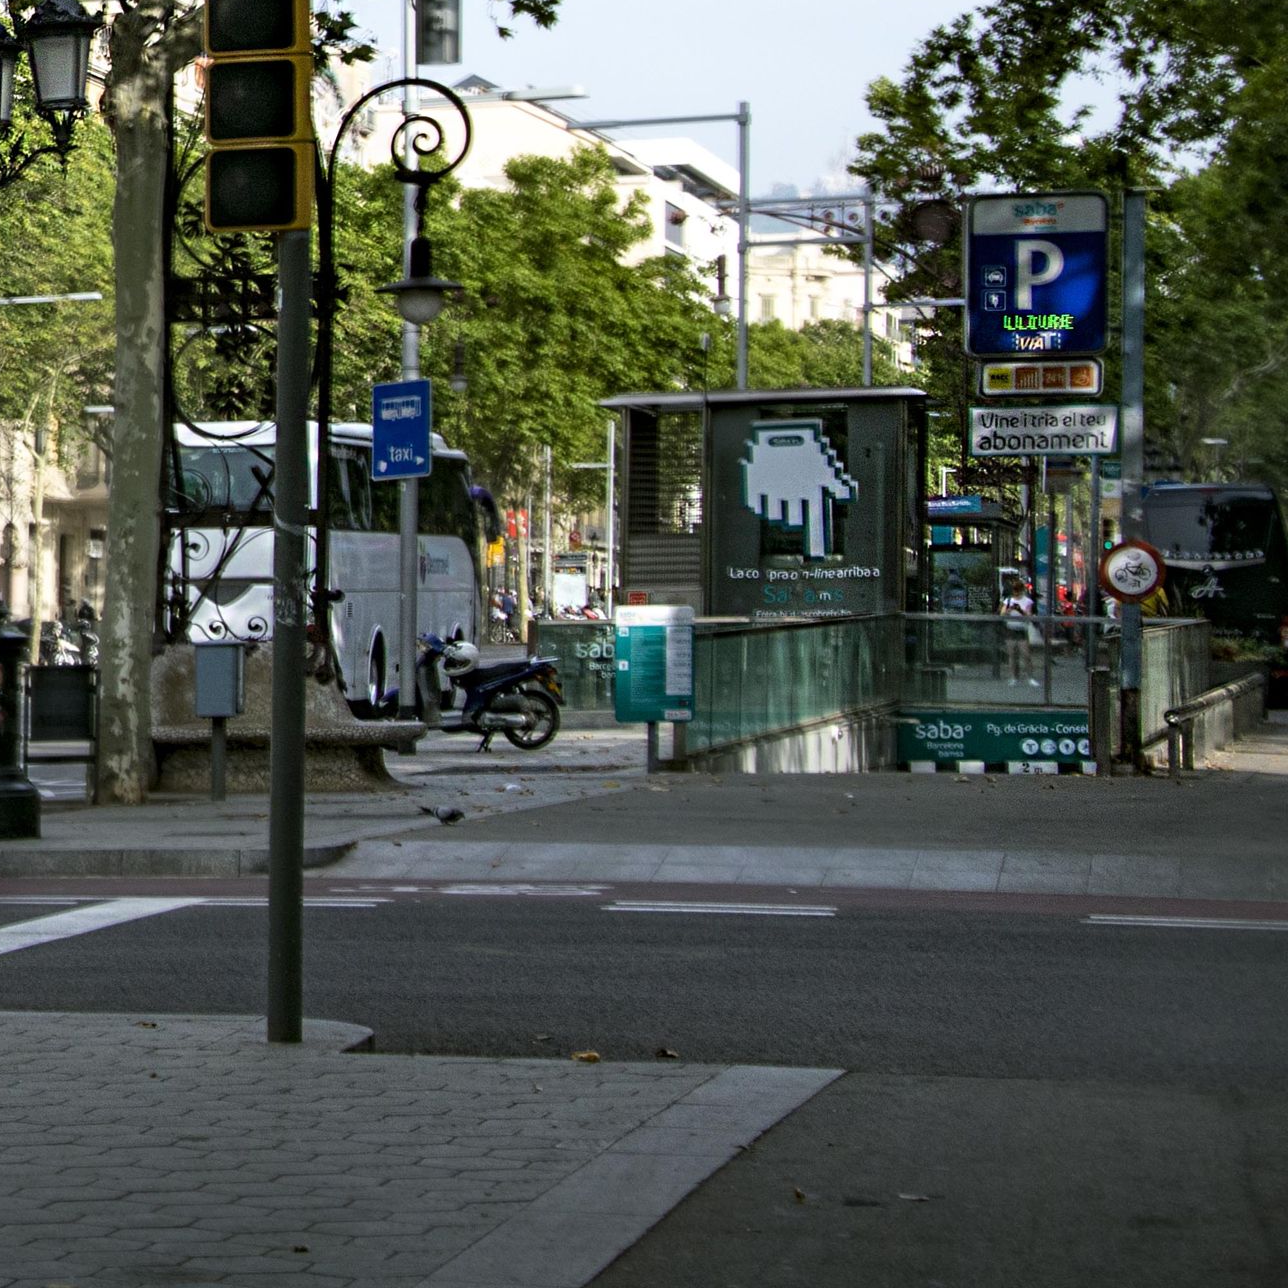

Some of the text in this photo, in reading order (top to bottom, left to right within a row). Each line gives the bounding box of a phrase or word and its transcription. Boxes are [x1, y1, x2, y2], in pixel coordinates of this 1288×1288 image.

[1015, 239, 1065, 311] P
[980, 413, 1019, 428] Vine
[1030, 413, 1059, 427] tria
[1062, 412, 1077, 427] el
[1080, 413, 1106, 426] teu
[978, 431, 1109, 451] abonament
[389, 443, 414, 463] taxi
[745, 570, 789, 582] copra
[836, 566, 871, 578] arriba
[1004, 722, 1017, 734] de
[1022, 762, 1031, 774] 2
